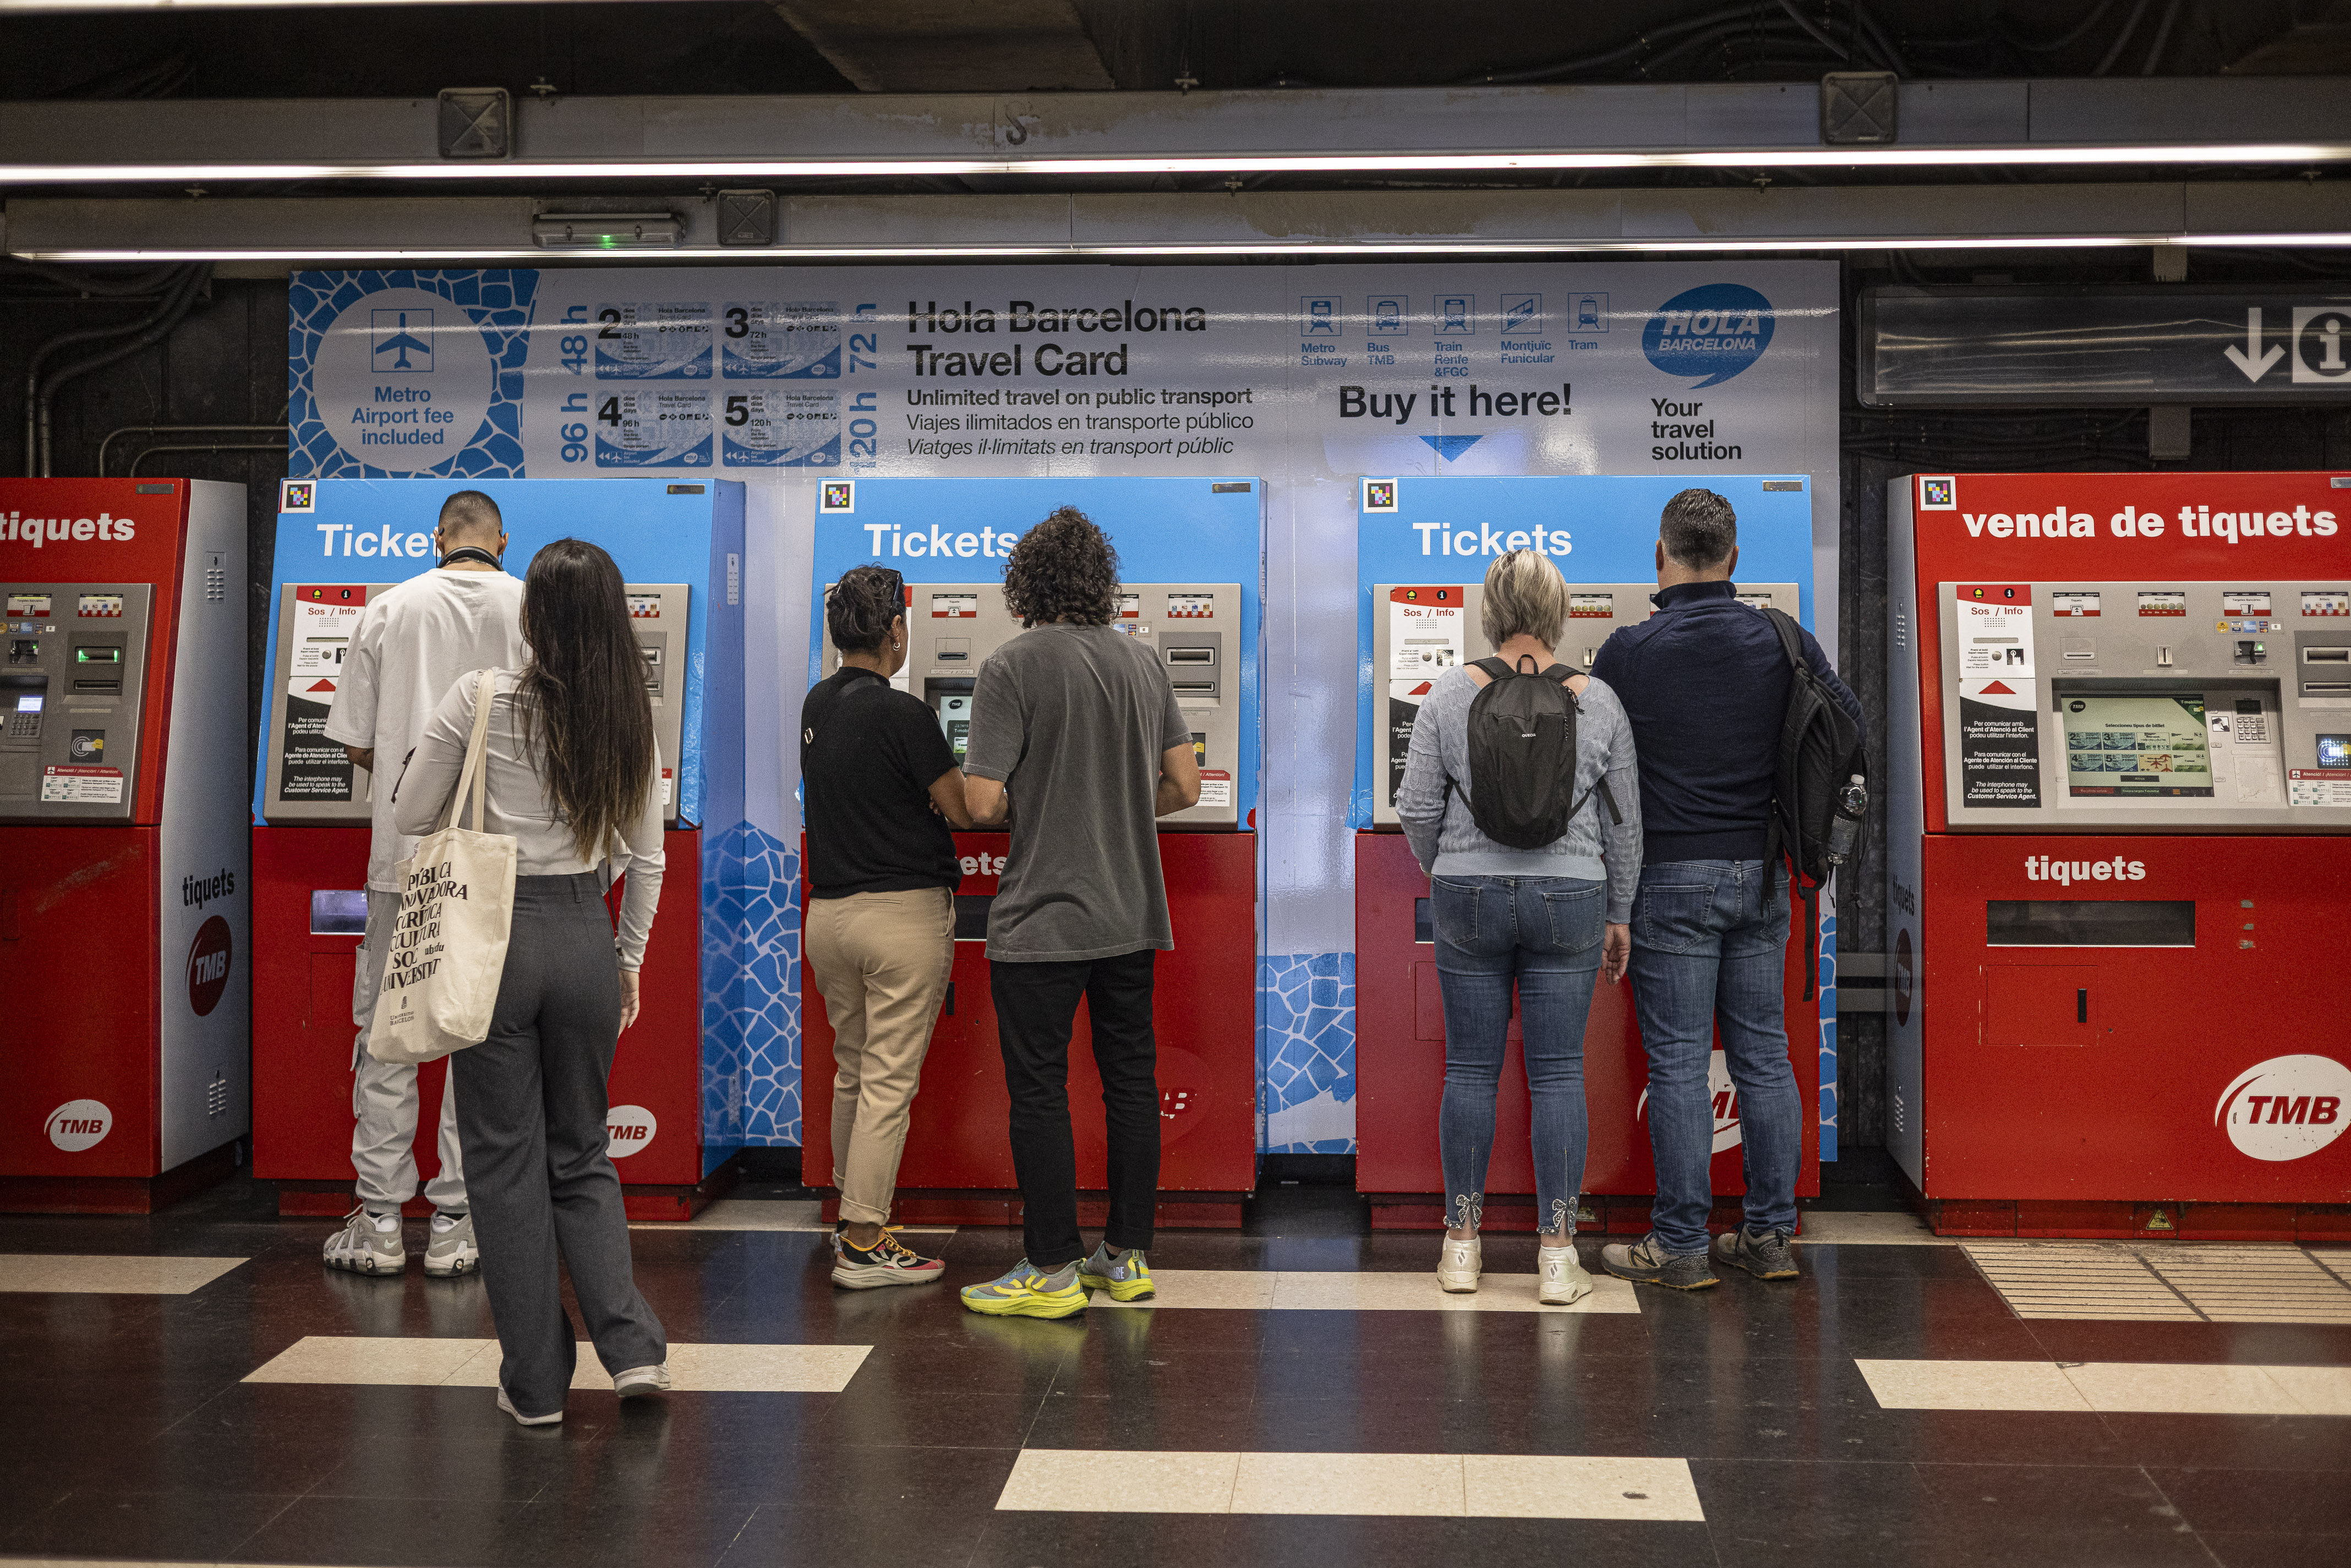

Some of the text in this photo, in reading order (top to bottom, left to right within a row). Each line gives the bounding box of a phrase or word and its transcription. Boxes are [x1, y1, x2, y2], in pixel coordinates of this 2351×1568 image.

[598, 308, 621, 340] 2
[725, 307, 750, 339] 3
[909, 299, 1206, 333] Hola Barcelona
[1663, 309, 1762, 336] HOLA
[560, 305, 588, 376] 48 h
[1302, 343, 1335, 353] Metro
[1368, 342, 1390, 353] Bus
[1434, 341, 1463, 352] Train
[1501, 340, 1552, 353] Montjuïc
[1568, 340, 1598, 350] Tram
[1659, 338, 1756, 351] BARCELONA
[849, 334, 877, 373] 72
[907, 343, 1128, 376] Travel Card
[1302, 356, 1348, 368] Subway
[1368, 356, 1395, 365] TMB
[1434, 354, 1469, 365] Renfe
[1501, 353, 1555, 364] Funicular
[1434, 367, 1469, 378] &FGC
[375, 386, 431, 402] Metro
[907, 387, 1253, 408] Unlimited travel on public transport
[1339, 383, 1572, 425] Buy it here!
[352, 408, 454, 427] Airport fee
[598, 396, 622, 428] 4
[725, 396, 750, 427] 5
[1651, 398, 1703, 417] Your
[560, 393, 588, 463] 96 h
[849, 392, 877, 475] 120 h
[906, 412, 1254, 435] Viajes ilimitados en transporte público
[1651, 419, 1714, 439] travel
[362, 429, 444, 445] included
[907, 437, 1234, 460] Viatges il·limitats en transport públic
[1652, 441, 1742, 461] solution
[1962, 505, 2339, 544] venda de tiquets
[863, 523, 1019, 558] Tickets
[1412, 522, 1573, 556] Tickets
[308, 608, 357, 616] Sos Info
[1403, 609, 1455, 617] Sos Info
[1971, 607, 1989, 615] Sos
[2025, 855, 2146, 886] tiquets
[182, 868, 235, 910] tiquets
[1893, 874, 1915, 917] tiquets
[195, 950, 226, 986] TMB
[2247, 1096, 2342, 1126] TMB
[59, 1119, 103, 1134] TMB
